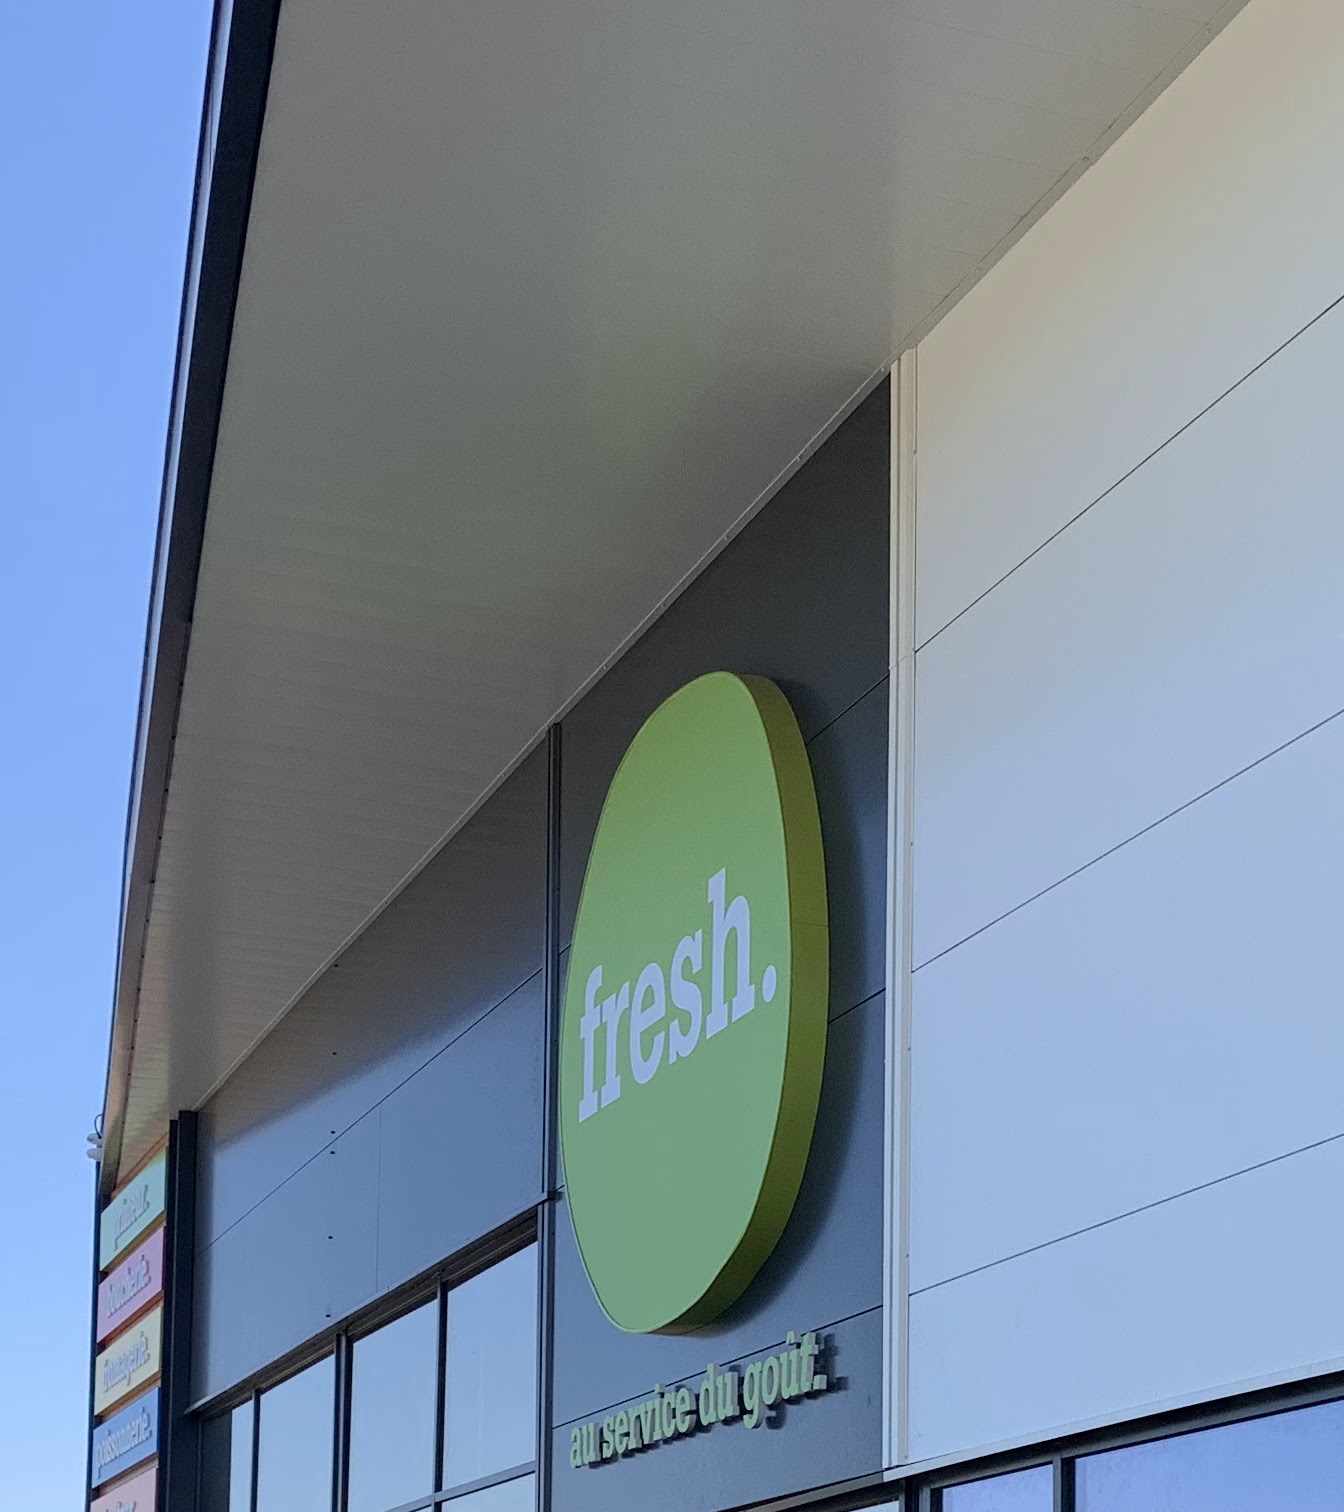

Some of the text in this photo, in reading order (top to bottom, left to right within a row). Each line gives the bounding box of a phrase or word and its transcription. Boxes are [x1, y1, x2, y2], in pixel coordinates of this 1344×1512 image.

[578, 868, 777, 1122] fresh.
[570, 1331, 827, 1468] au service du goût.
